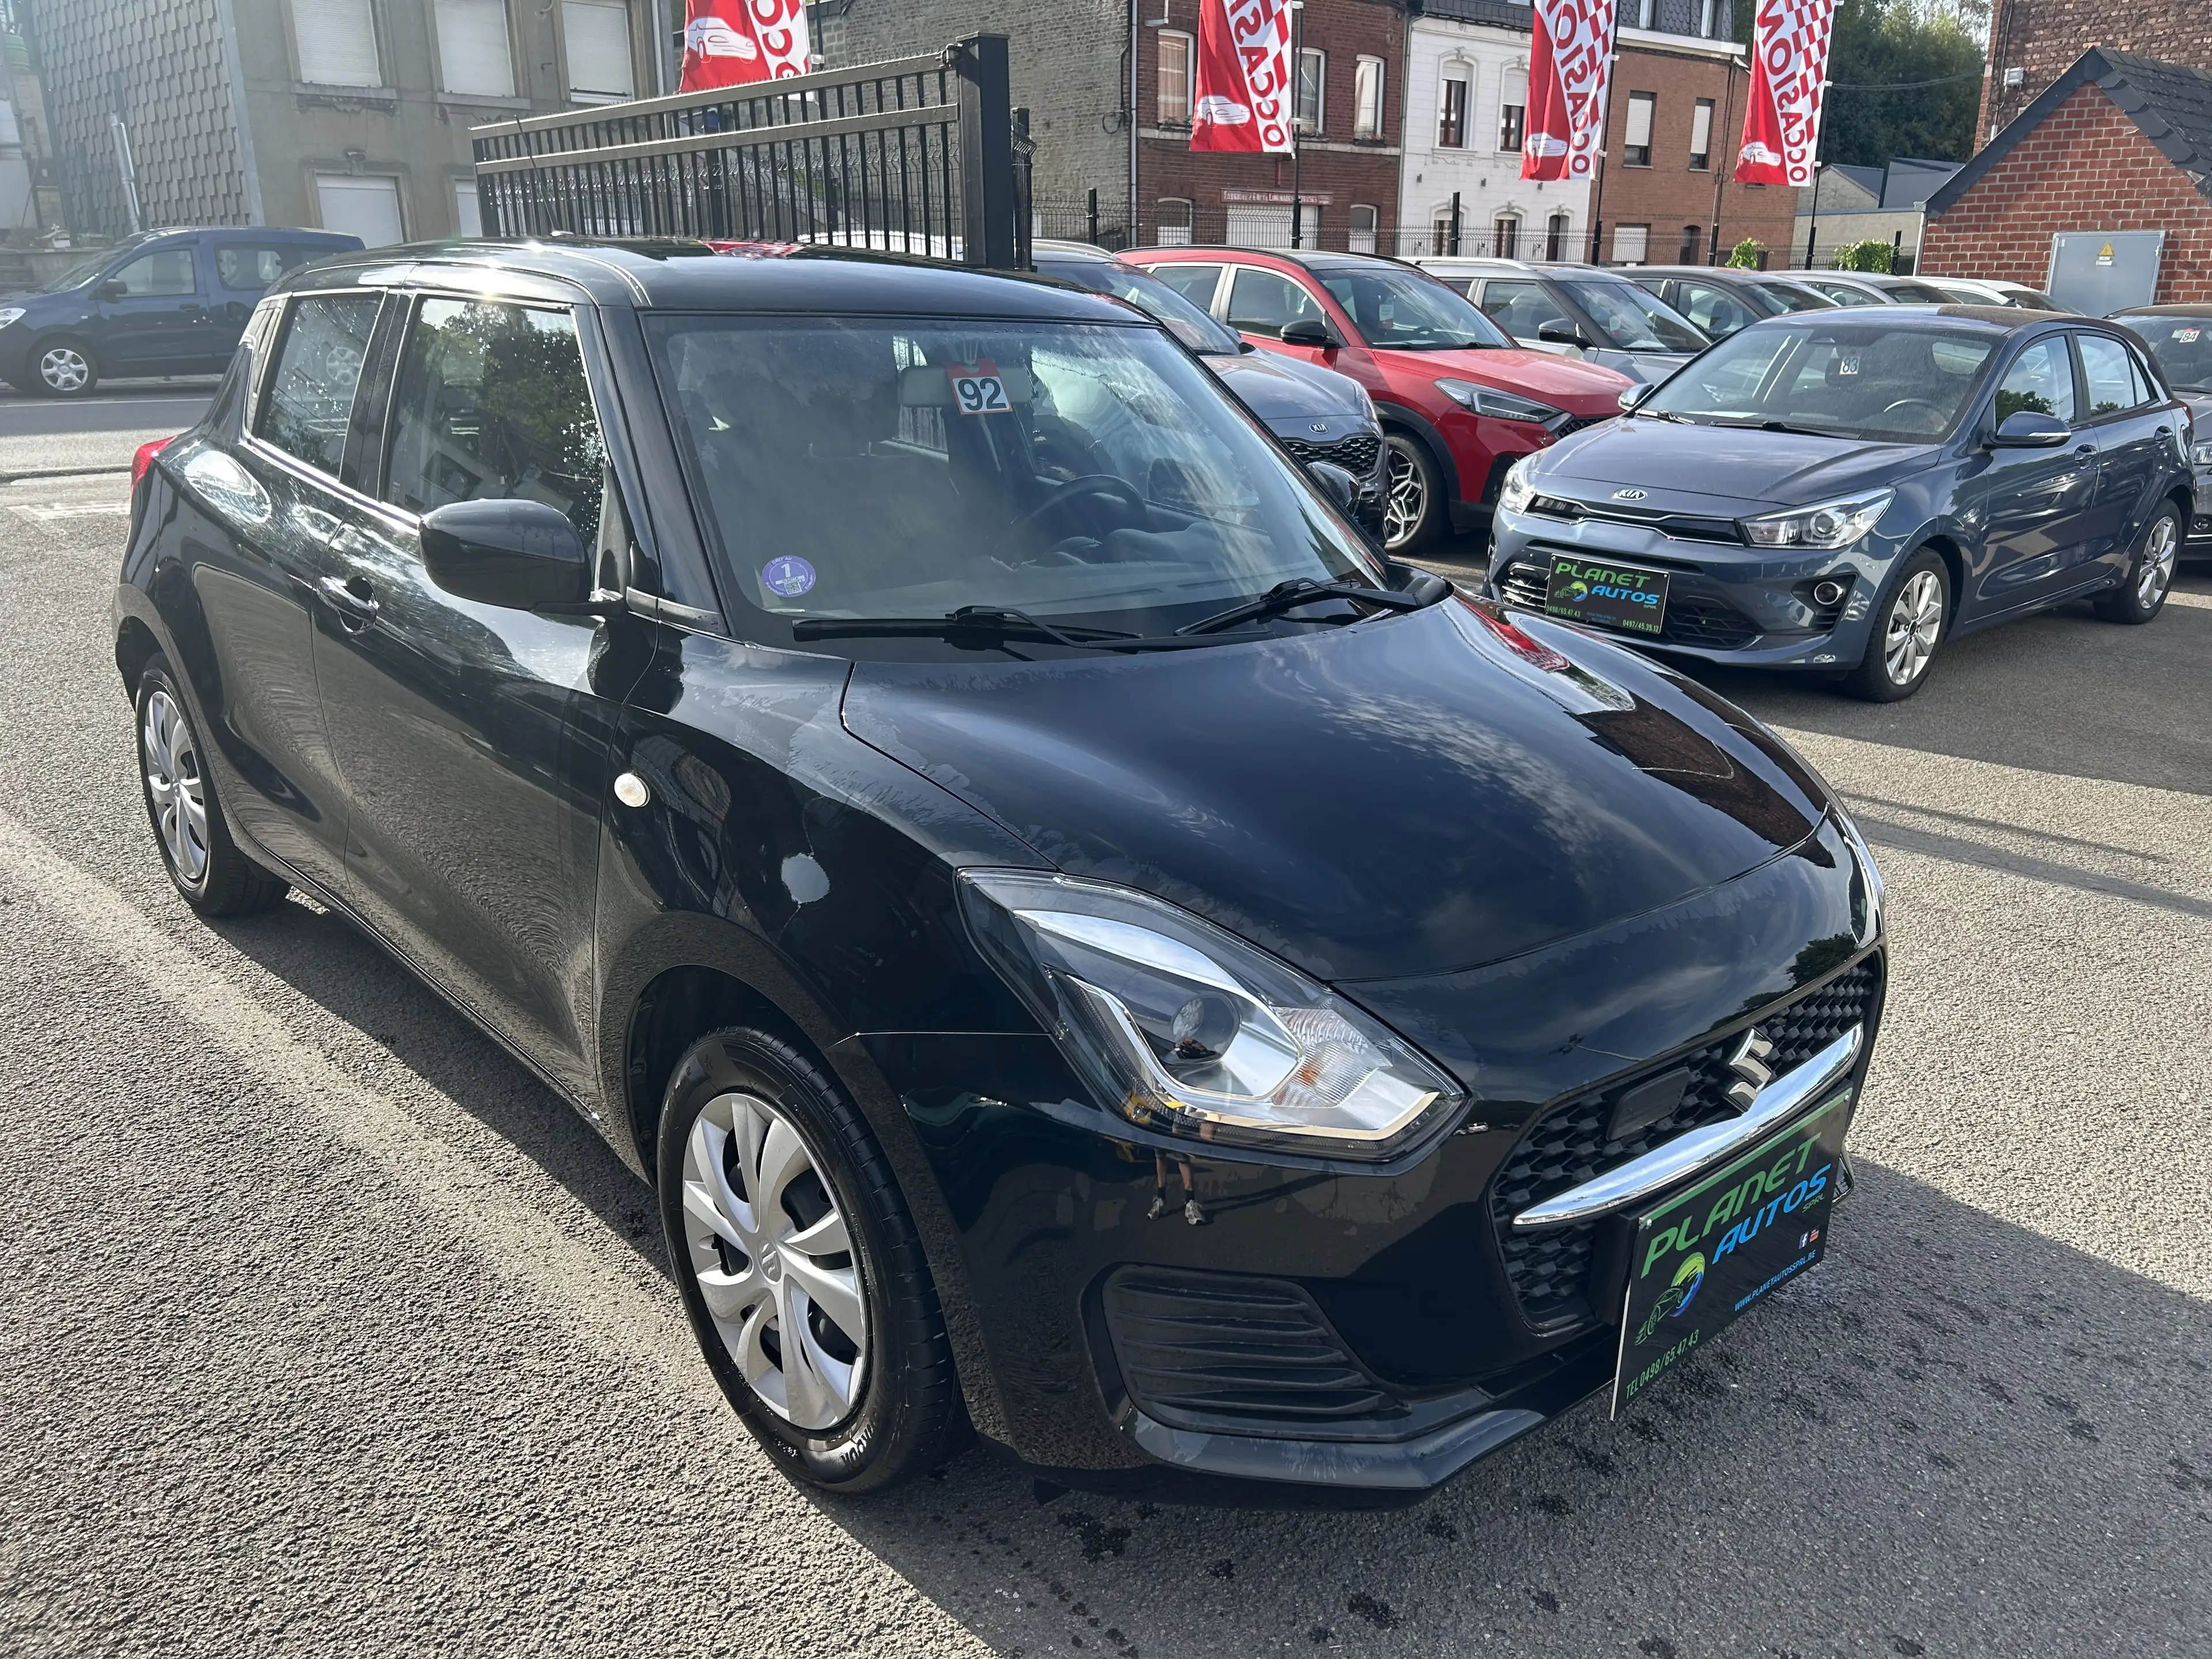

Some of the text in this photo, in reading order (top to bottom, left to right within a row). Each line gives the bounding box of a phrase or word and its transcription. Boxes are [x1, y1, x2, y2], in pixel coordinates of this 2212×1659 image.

[2183, 332, 2197, 342] 84
[1842, 357, 1858, 373] 83
[958, 378, 1007, 411] 92
[1312, 423, 1327, 431] KIA
[1619, 490, 1641, 498] KIA
[781, 563, 791, 578] 1
[1555, 562, 1650, 588] PLANET
[1591, 585, 1660, 605] AUTOS
[1641, 1131, 1822, 1279] PLANET
[1802, 1193, 1825, 1213] SPRL
[1712, 1163, 1832, 1265] AUTOS
[1734, 1249, 1816, 1312] WWW.PLANETAUTOSSPRL.BE
[1626, 1328, 1699, 1400] TEL 0498/65.47.43
